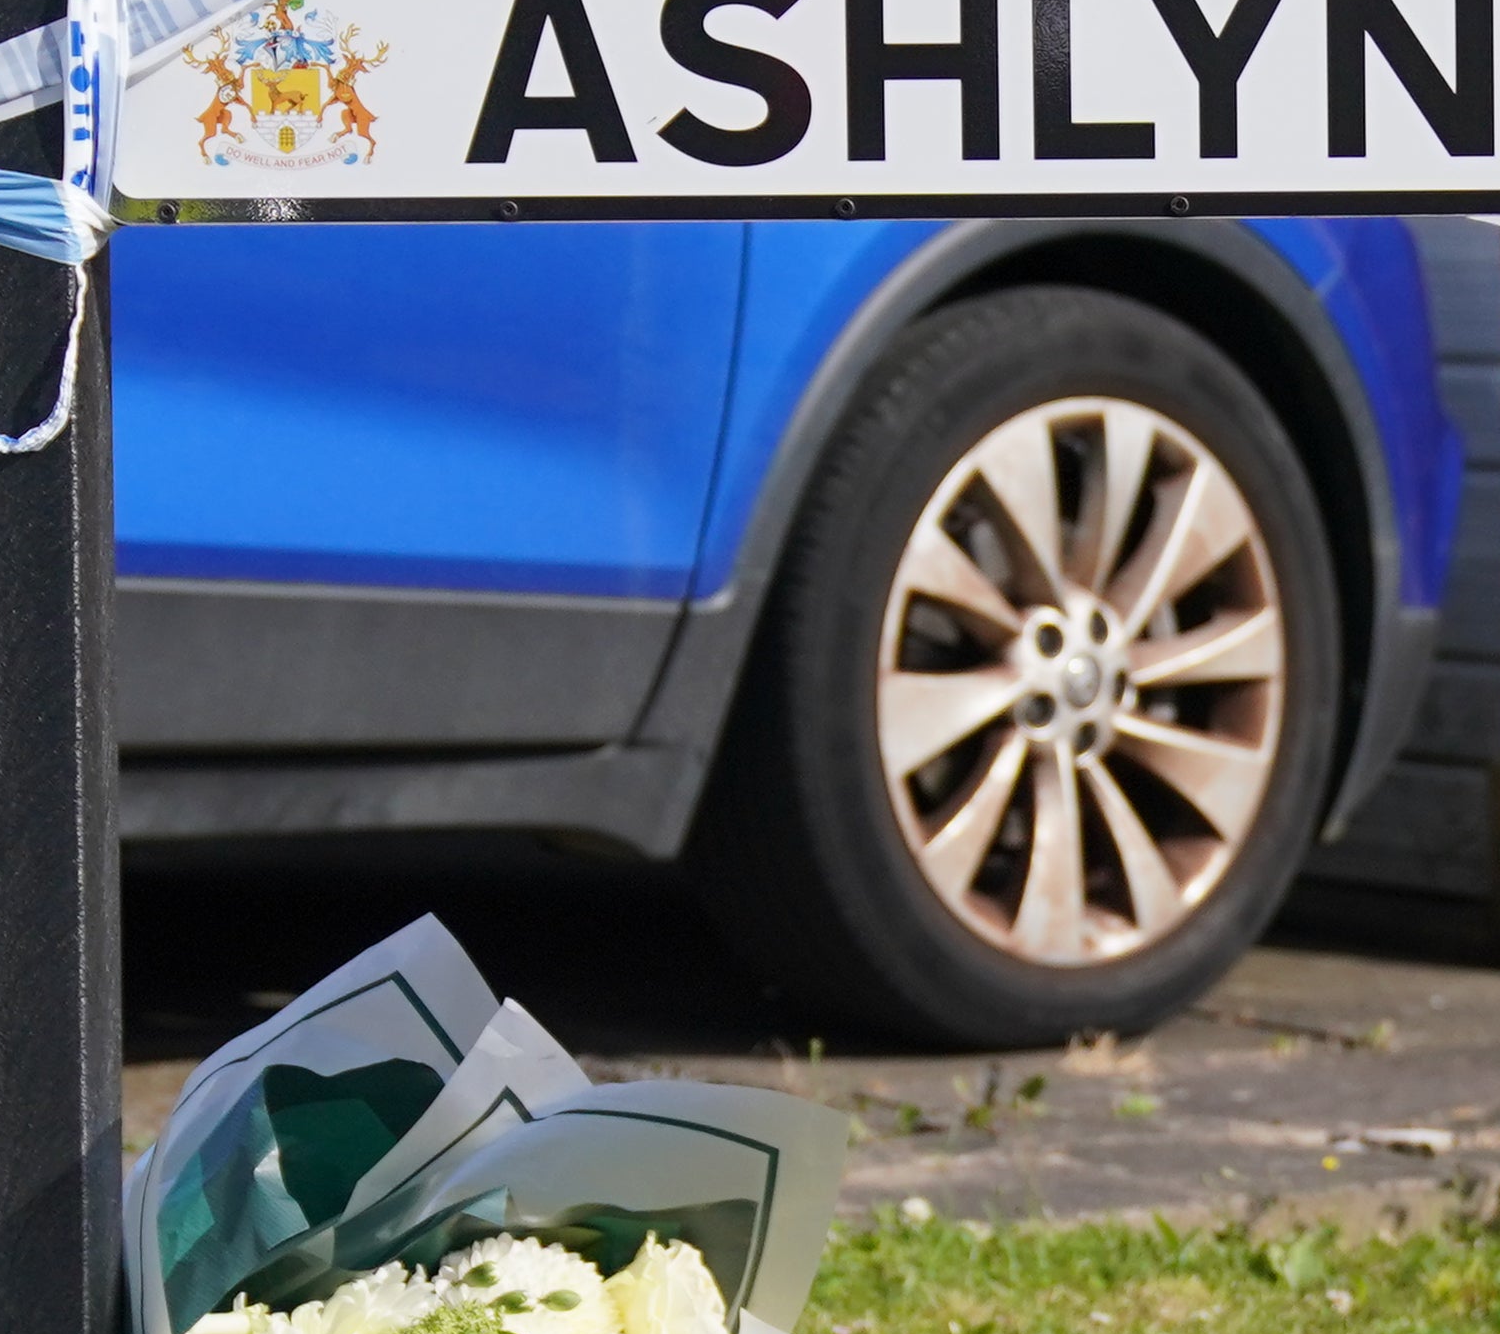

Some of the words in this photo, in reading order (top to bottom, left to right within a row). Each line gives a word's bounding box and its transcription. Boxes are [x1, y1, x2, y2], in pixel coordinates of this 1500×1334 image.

[226, 145, 241, 159] DO
[244, 151, 272, 167] WELL
[274, 157, 295, 168] AND
[298, 154, 326, 167] FEAR
[327, 144, 348, 159] NOT
